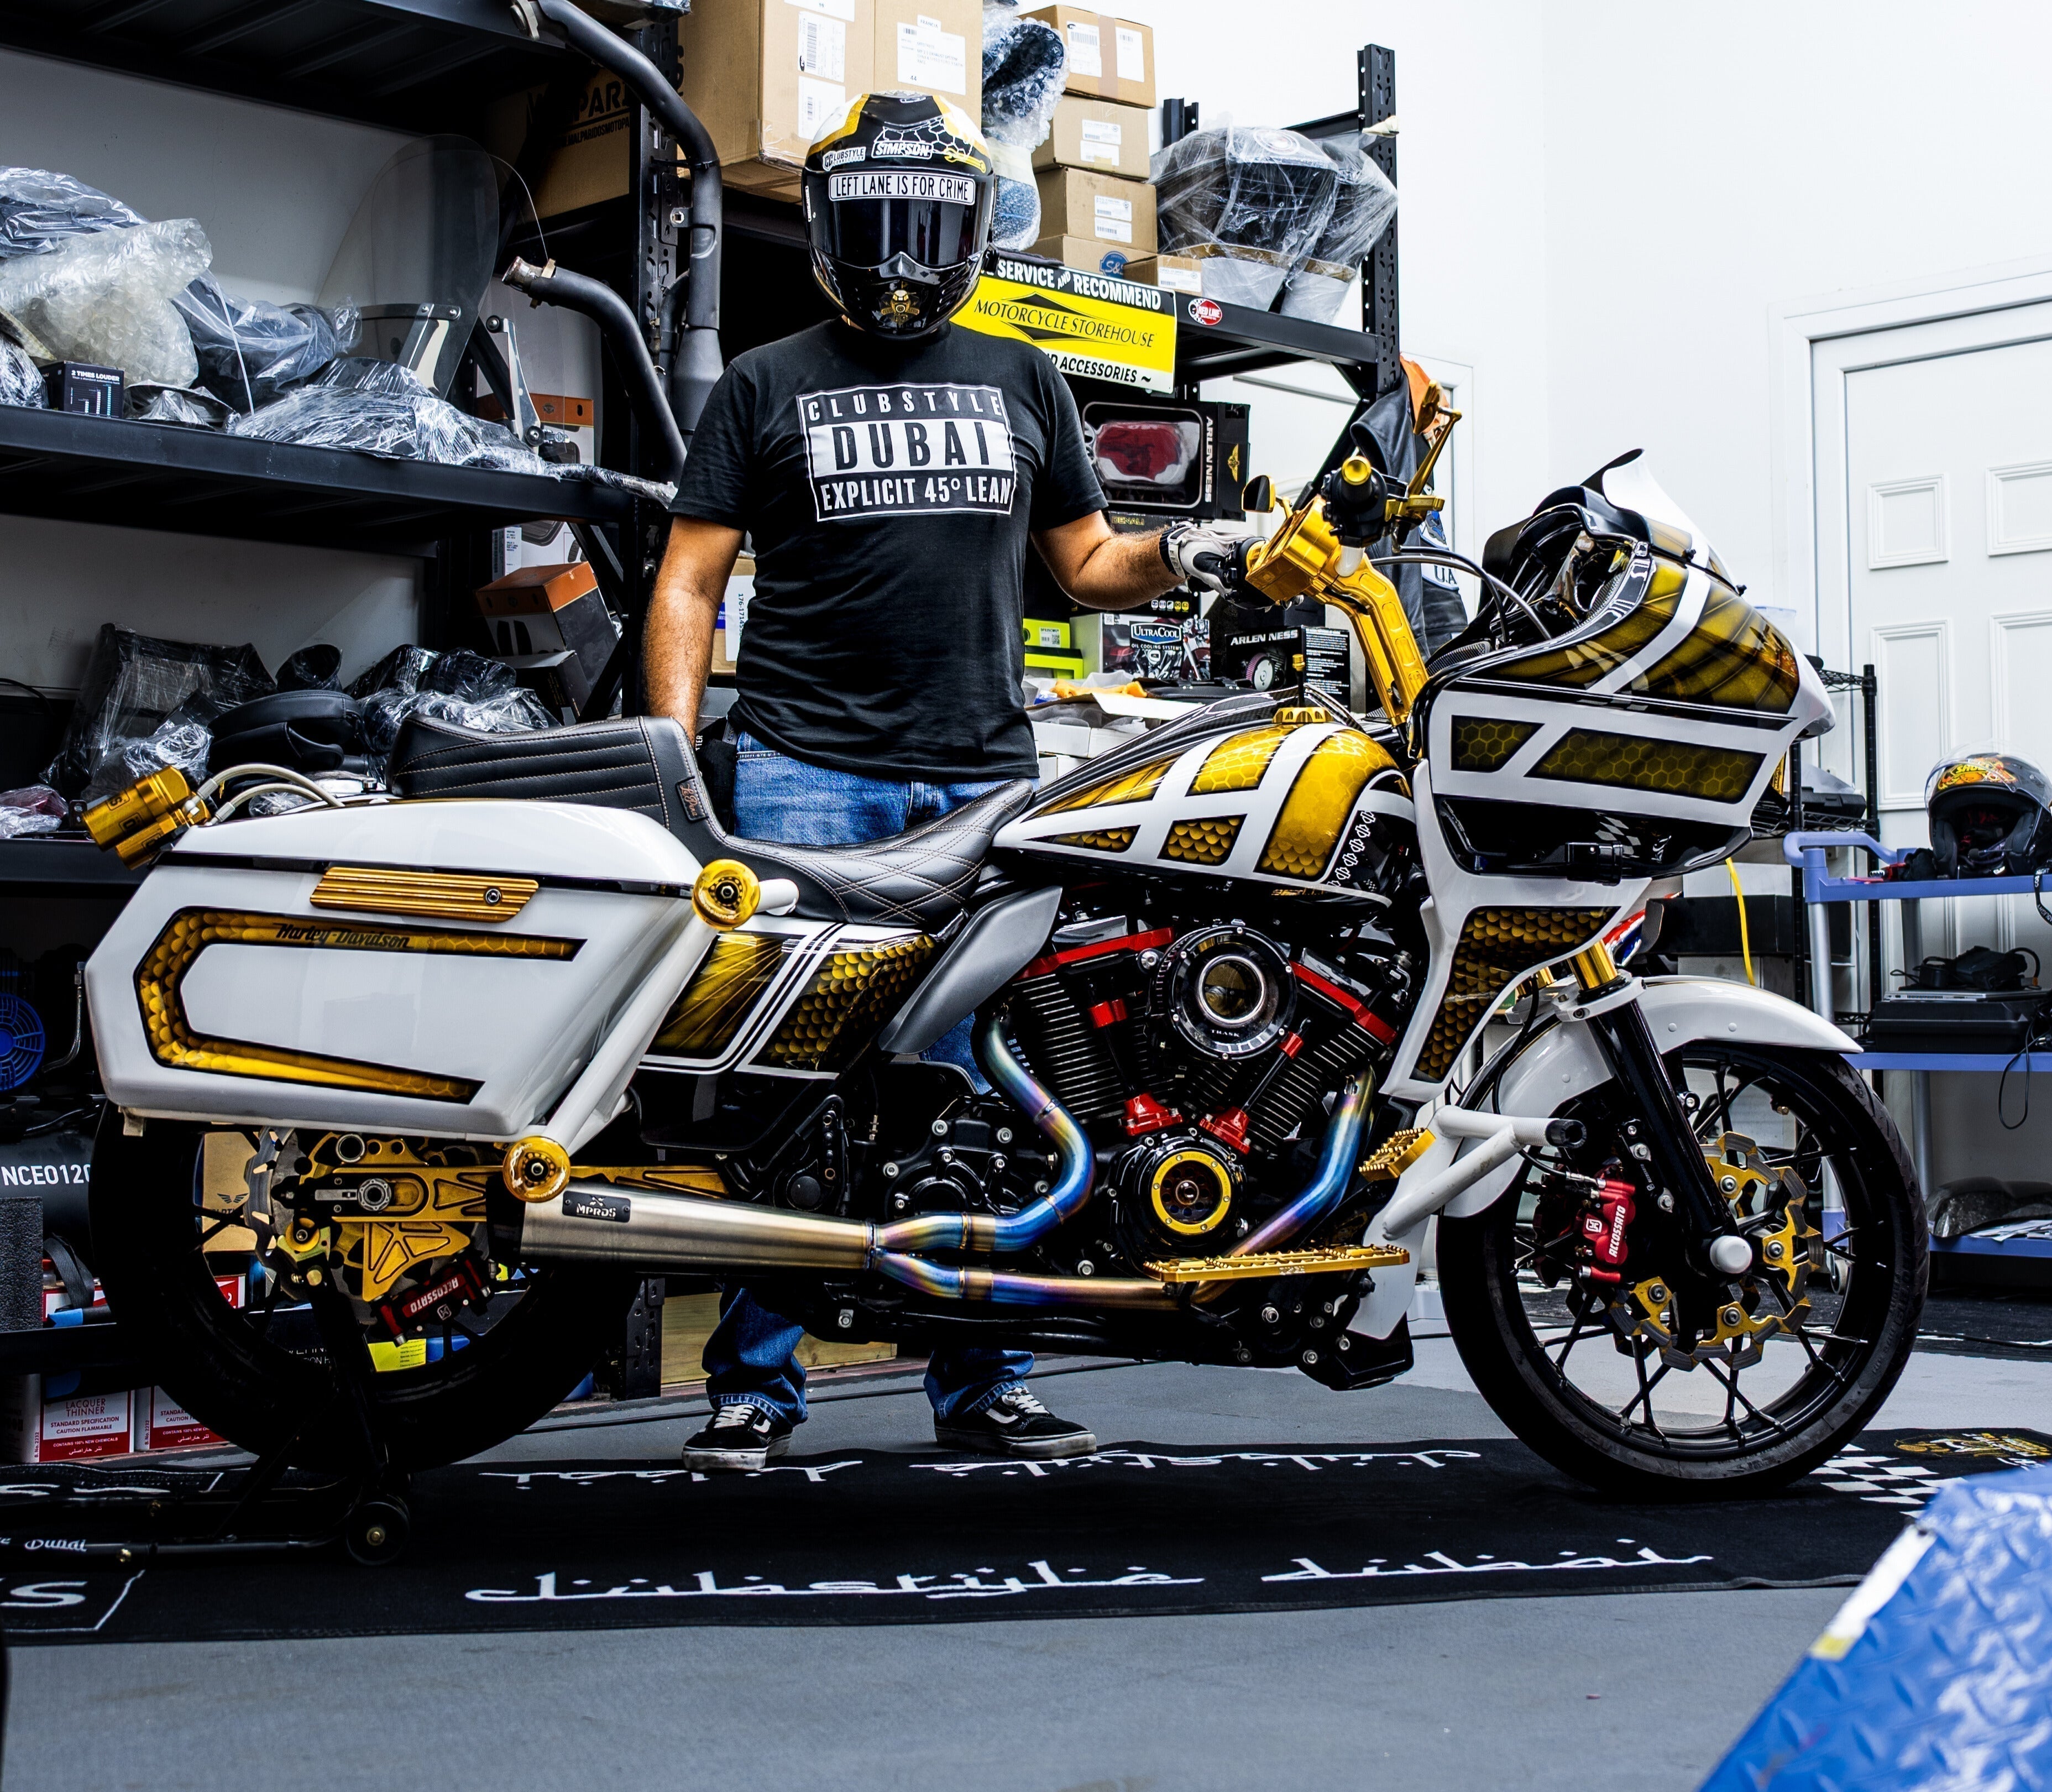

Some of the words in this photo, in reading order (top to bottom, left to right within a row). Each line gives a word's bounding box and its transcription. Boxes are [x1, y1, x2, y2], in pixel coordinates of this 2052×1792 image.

[876, 142, 930, 157] SIMPSON
[836, 176, 859, 196] LEFT
[862, 175, 892, 195] LANE
[897, 175, 908, 195] IS
[913, 176, 934, 196] FOR
[939, 179, 969, 200] CRIME
[997, 259, 1055, 288] SERVICE
[1058, 271, 1071, 289] AND
[1073, 275, 1161, 310] RECOMMEND
[974, 299, 1067, 330] MOTORCYCLE
[1070, 318, 1155, 348] STOREHOUSE
[76, 370, 96, 379] TIMES
[96, 373, 120, 382] LOUDER
[1060, 356, 1137, 383] ACCESSORIES
[808, 391, 1002, 421] CLUBSTYLE
[832, 421, 990, 471] DUBAI
[821, 478, 915, 510] EXPLICIT
[966, 476, 1011, 504] LEAN
[1205, 466, 1213, 503] NESS
[1112, 516, 1144, 525] DENALI
[1231, 634, 1266, 646] ARLEN
[1269, 629, 1299, 641] NESS
[273, 923, 414, 949] Harley-Davidson
[1609, 1205, 1626, 1258] ACCOSSATO
[410, 1277, 459, 1313] ACCOSSATO
[66, 1398, 106, 1409] LACQUER
[66, 1407, 105, 1417] THINNER
[81, 1416, 119, 1425] SPECIFICATION
